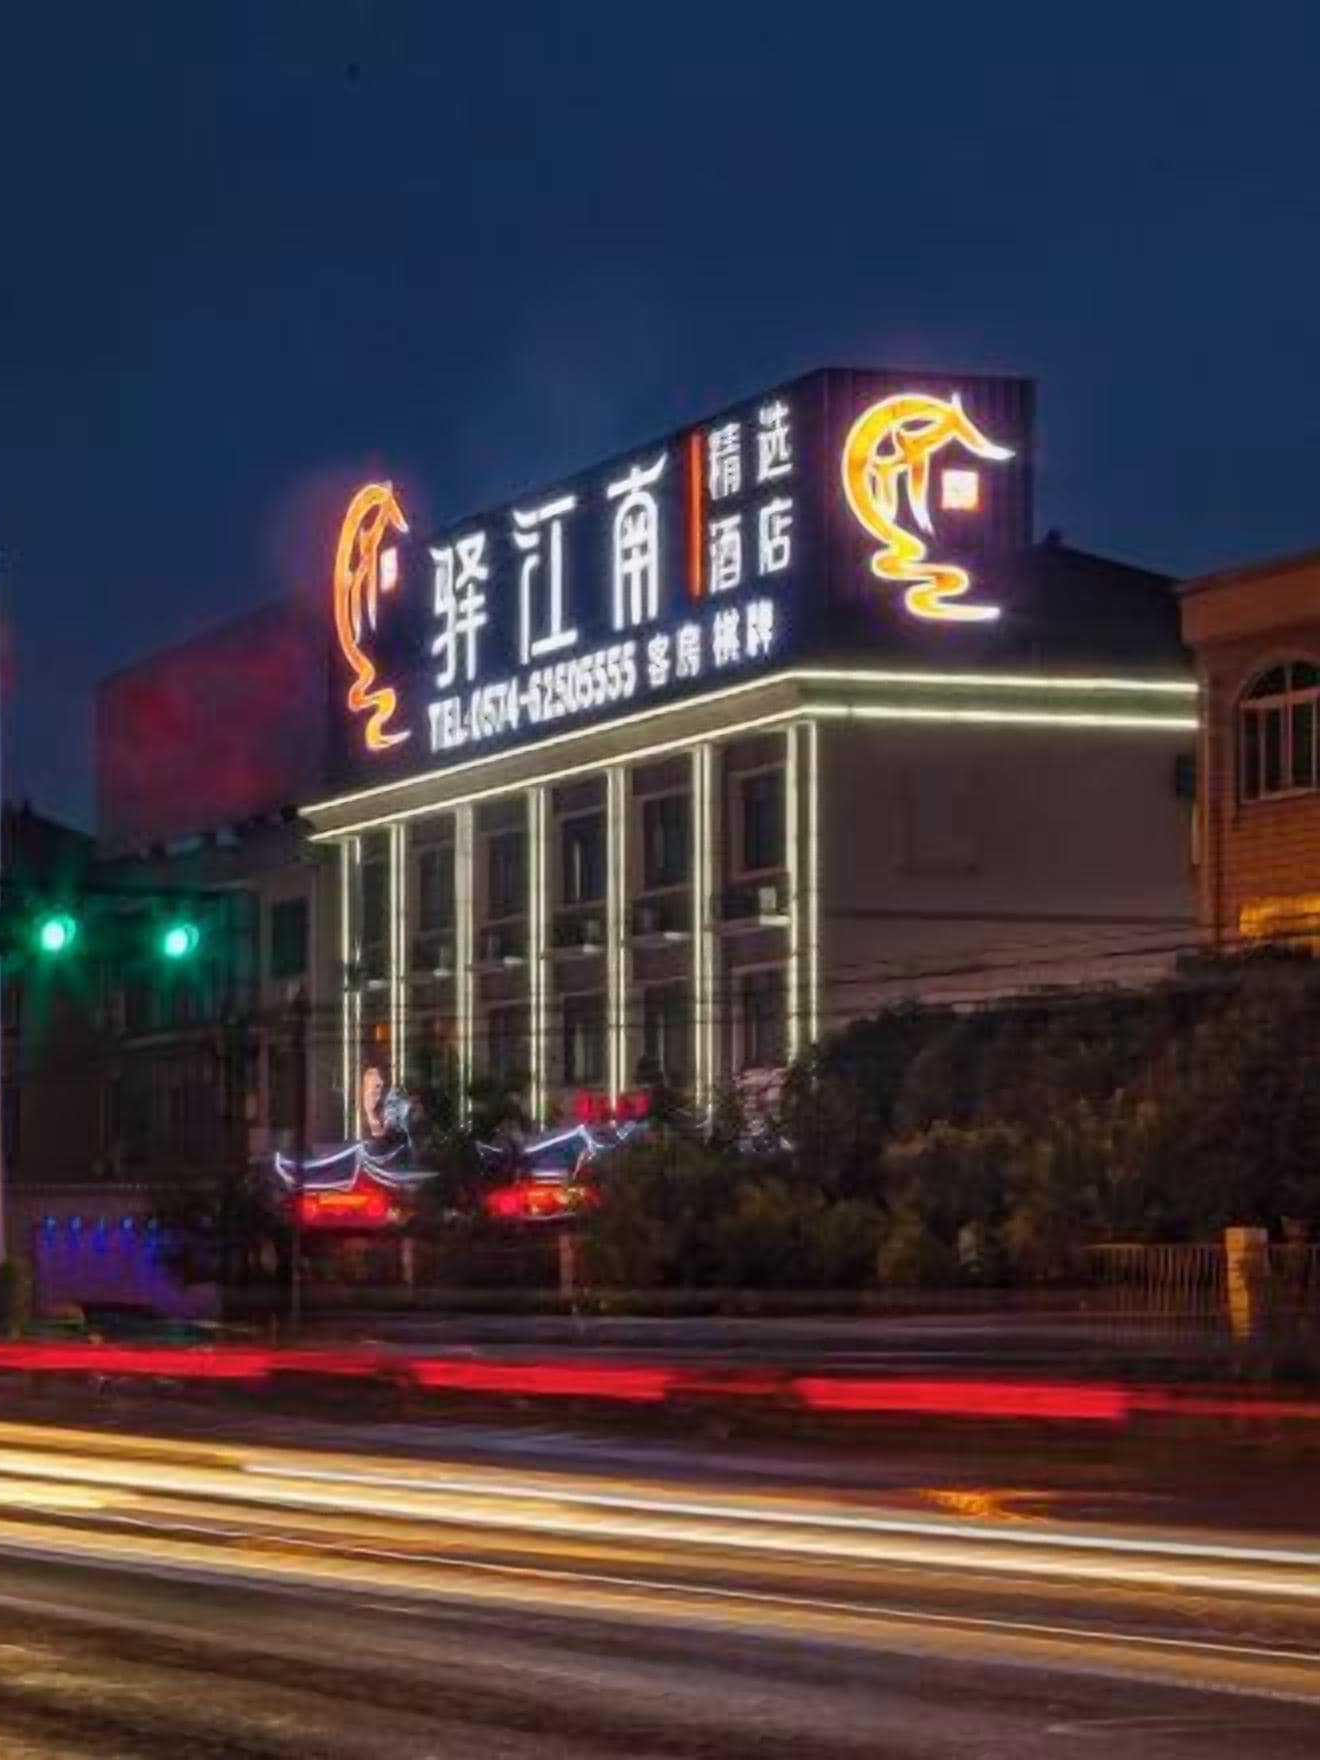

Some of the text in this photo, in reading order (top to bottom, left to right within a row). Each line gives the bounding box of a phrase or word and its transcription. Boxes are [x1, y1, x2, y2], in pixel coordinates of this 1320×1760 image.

[708, 400, 793, 500] 精选
[429, 452, 668, 689] 驿江南
[709, 498, 793, 595] 酒店
[646, 622, 702, 688] 客房
